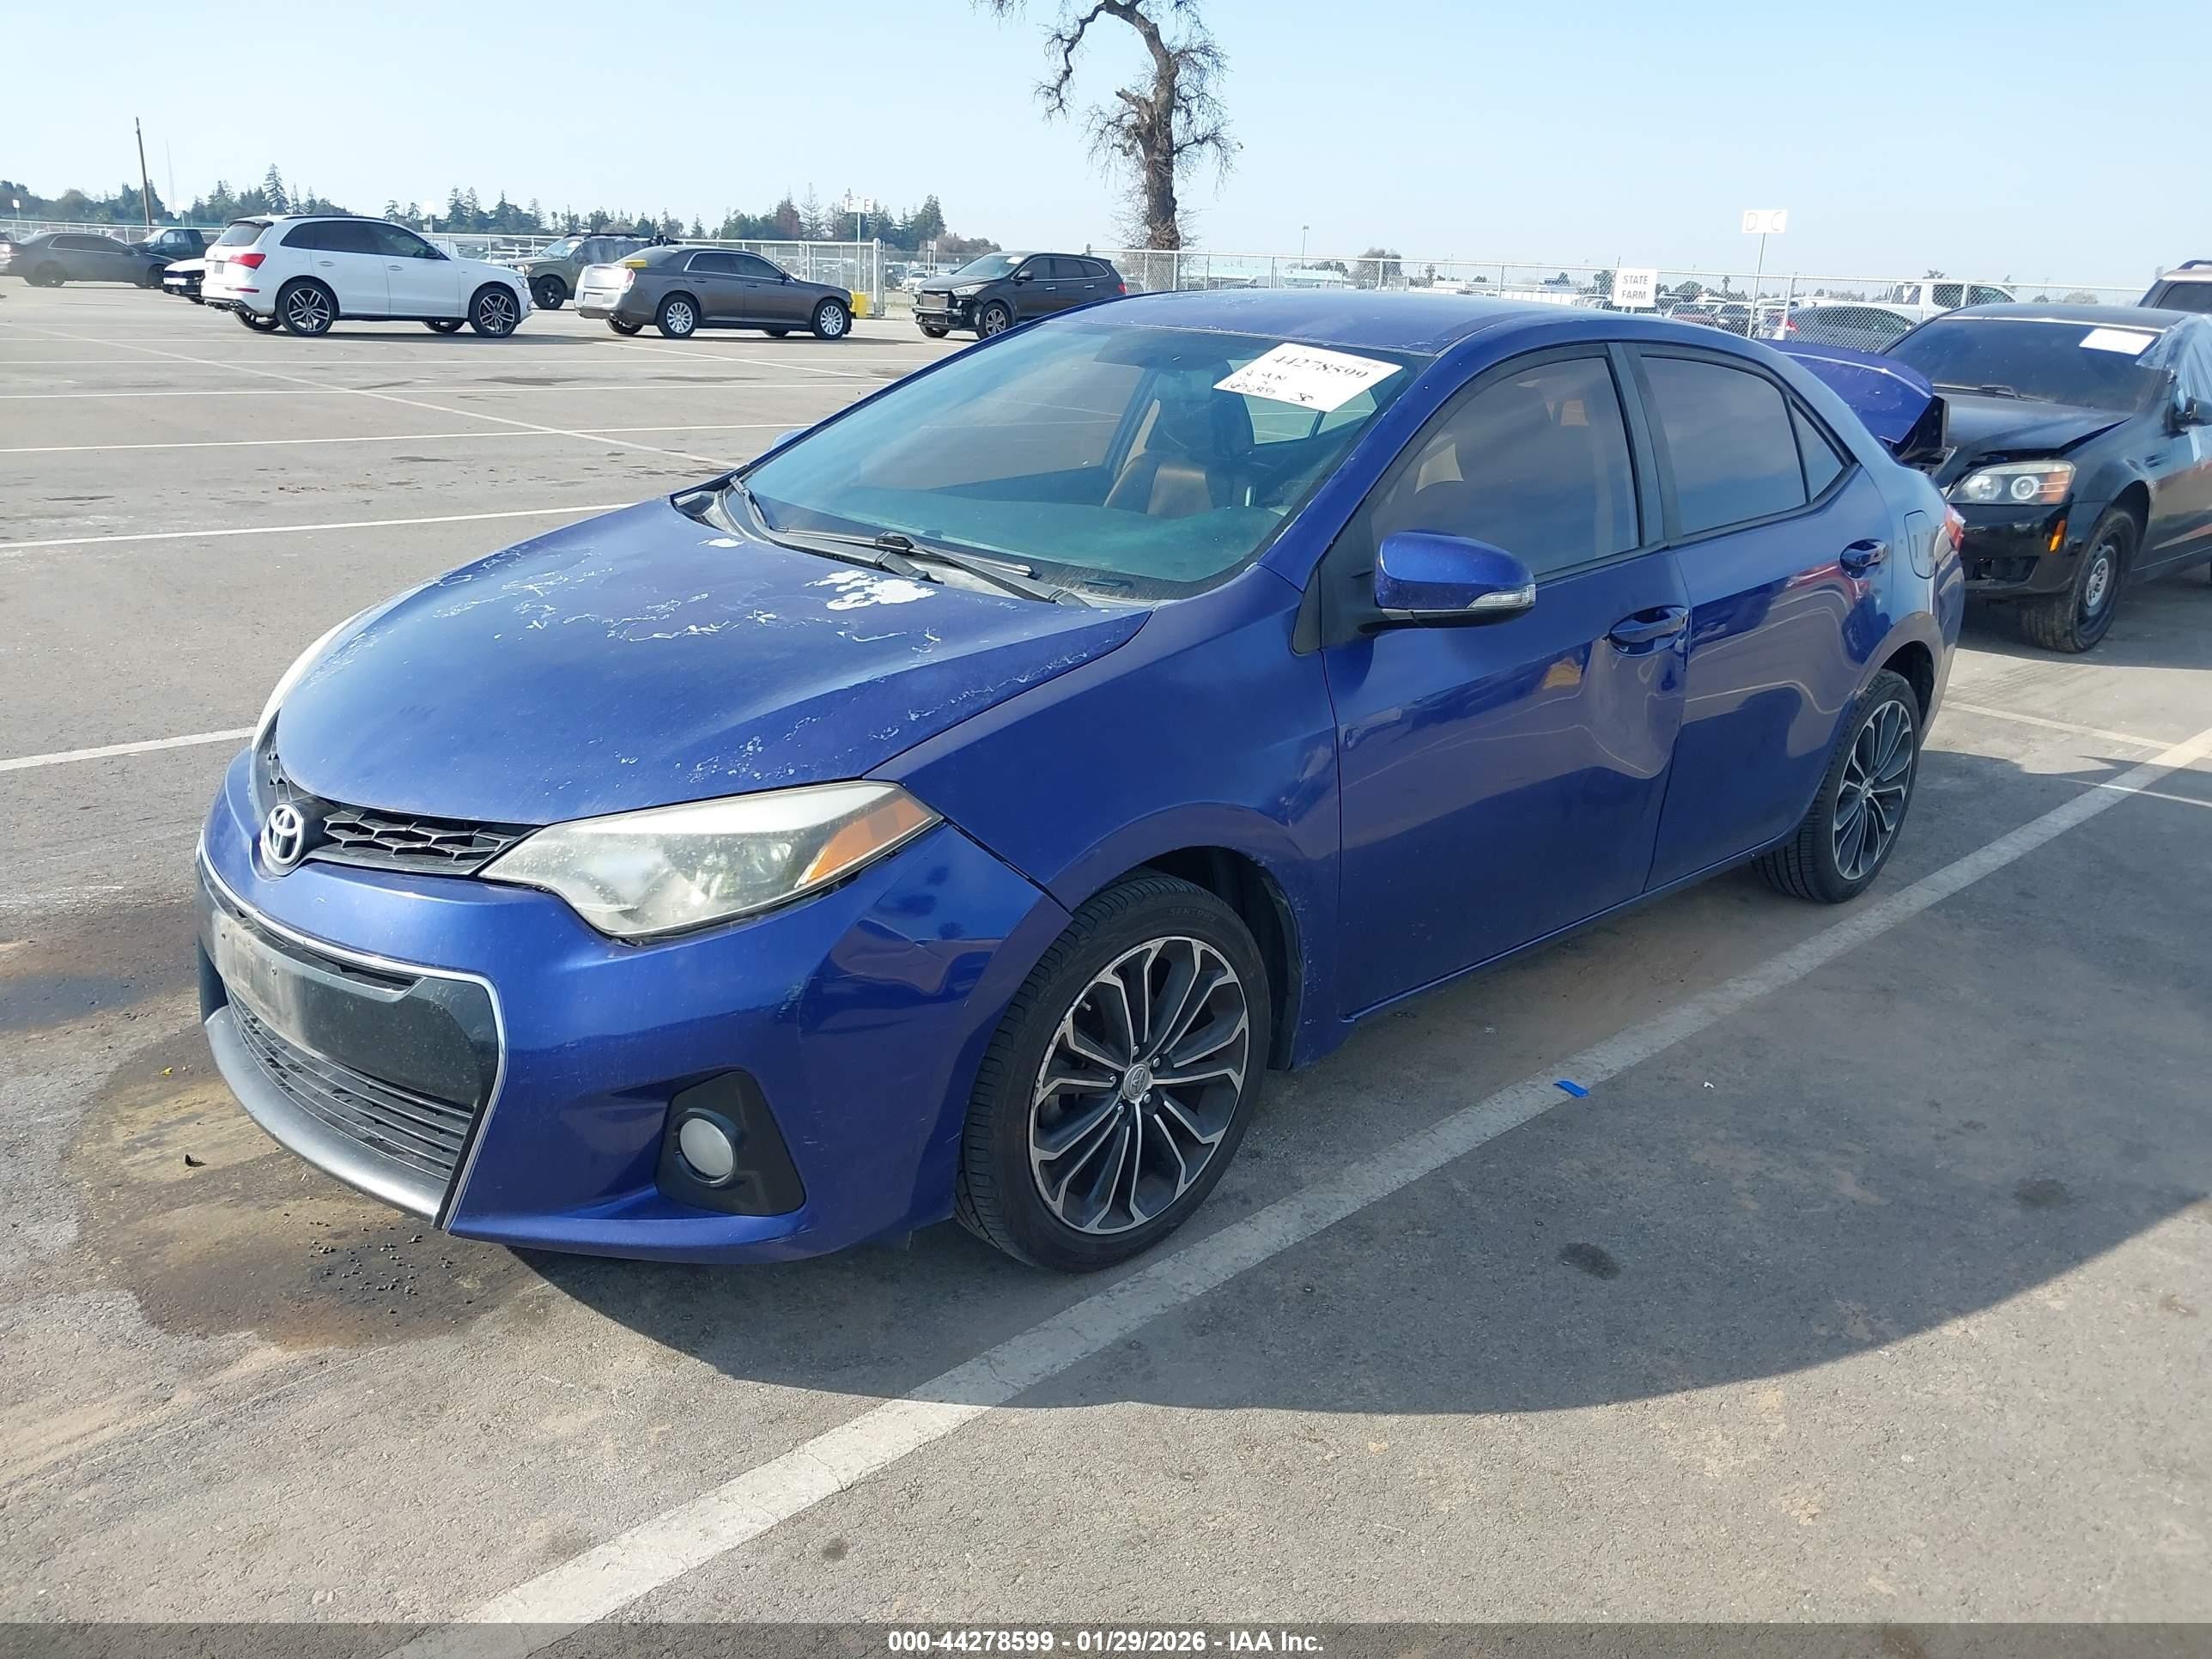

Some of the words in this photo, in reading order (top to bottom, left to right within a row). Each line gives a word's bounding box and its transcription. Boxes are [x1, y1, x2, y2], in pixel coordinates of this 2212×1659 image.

[1623, 275, 1649, 285] STATE
[1622, 289, 1647, 301] FARM
[1273, 356, 1368, 379] 44278599
